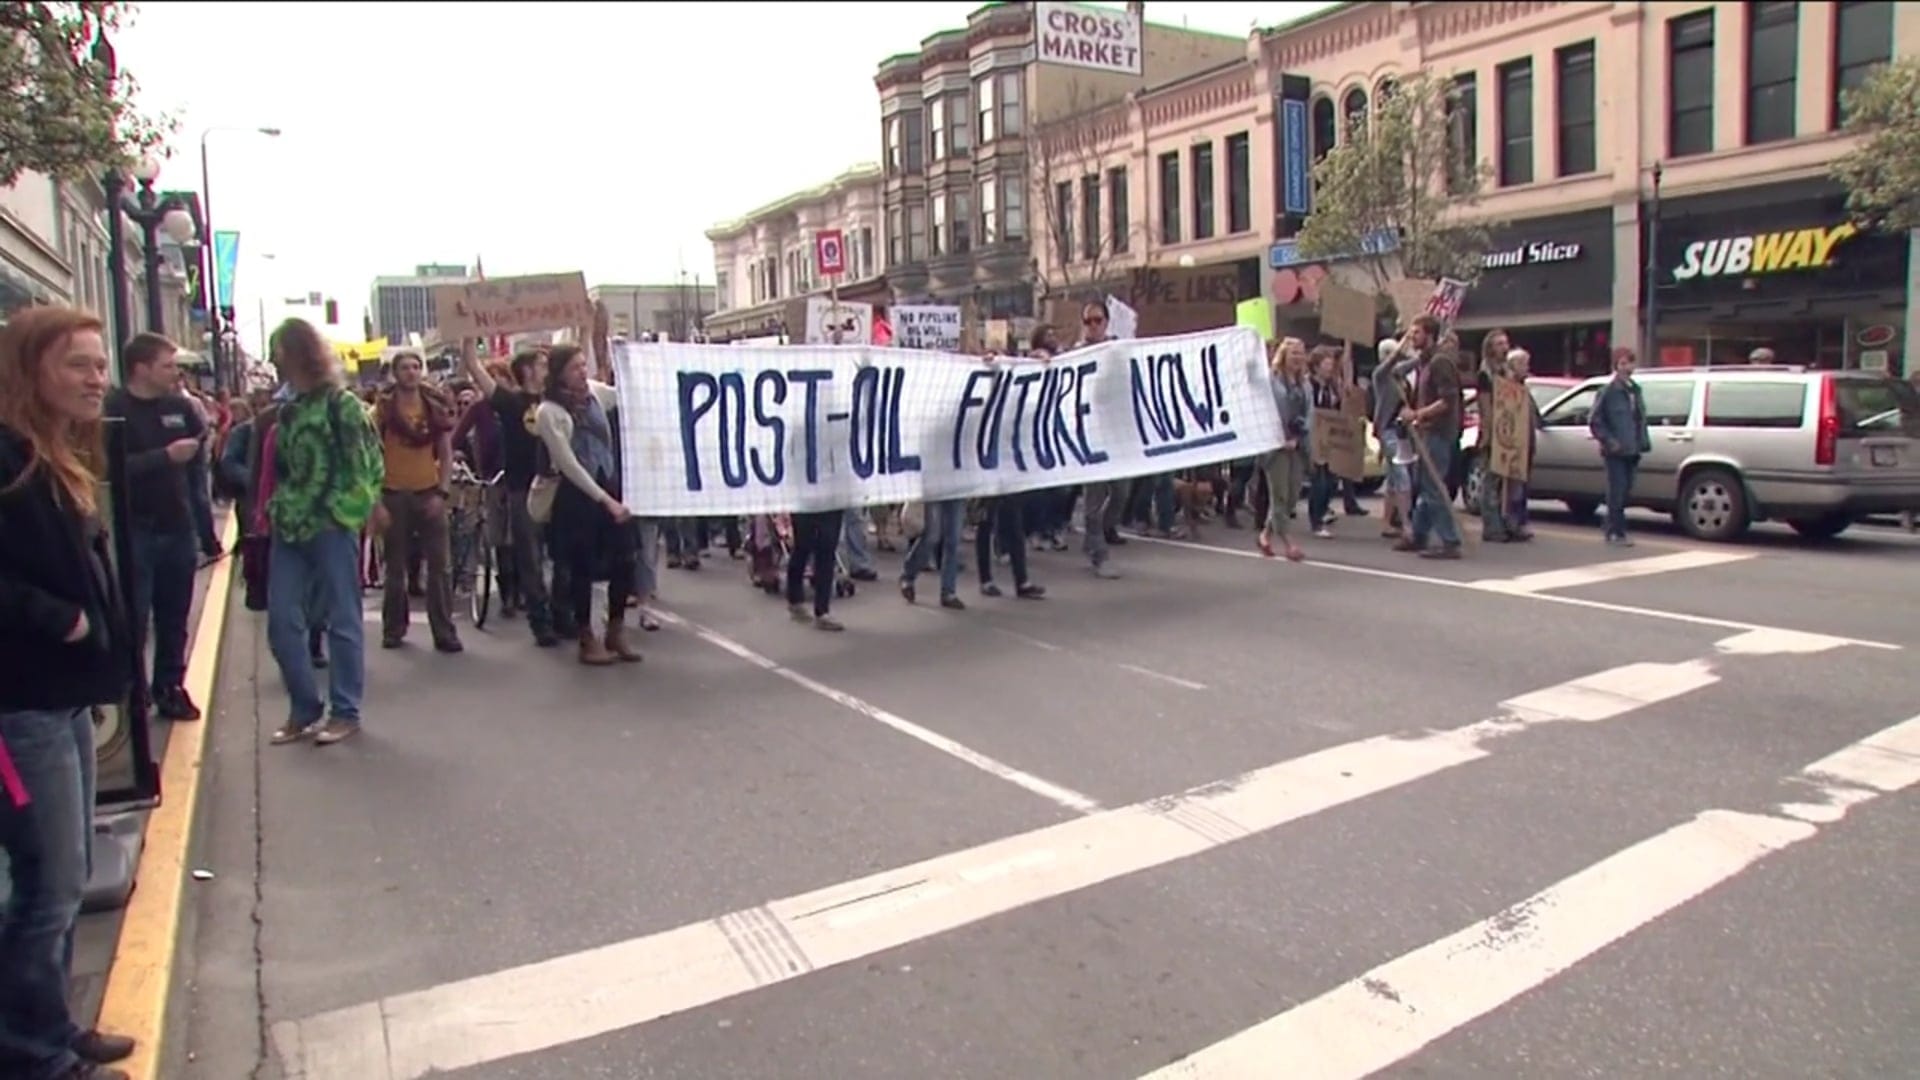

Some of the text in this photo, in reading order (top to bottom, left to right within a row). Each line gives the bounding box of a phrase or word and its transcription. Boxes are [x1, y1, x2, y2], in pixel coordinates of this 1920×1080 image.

[1043, 32, 1138, 67] MARKET
[1529, 241, 1579, 263] Slice
[1673, 222, 1856, 281] SUBWAY
[677, 366, 921, 491] POST-OIL
[953, 361, 1109, 472] FUTURE
[1130, 343, 1230, 446] NOW!
